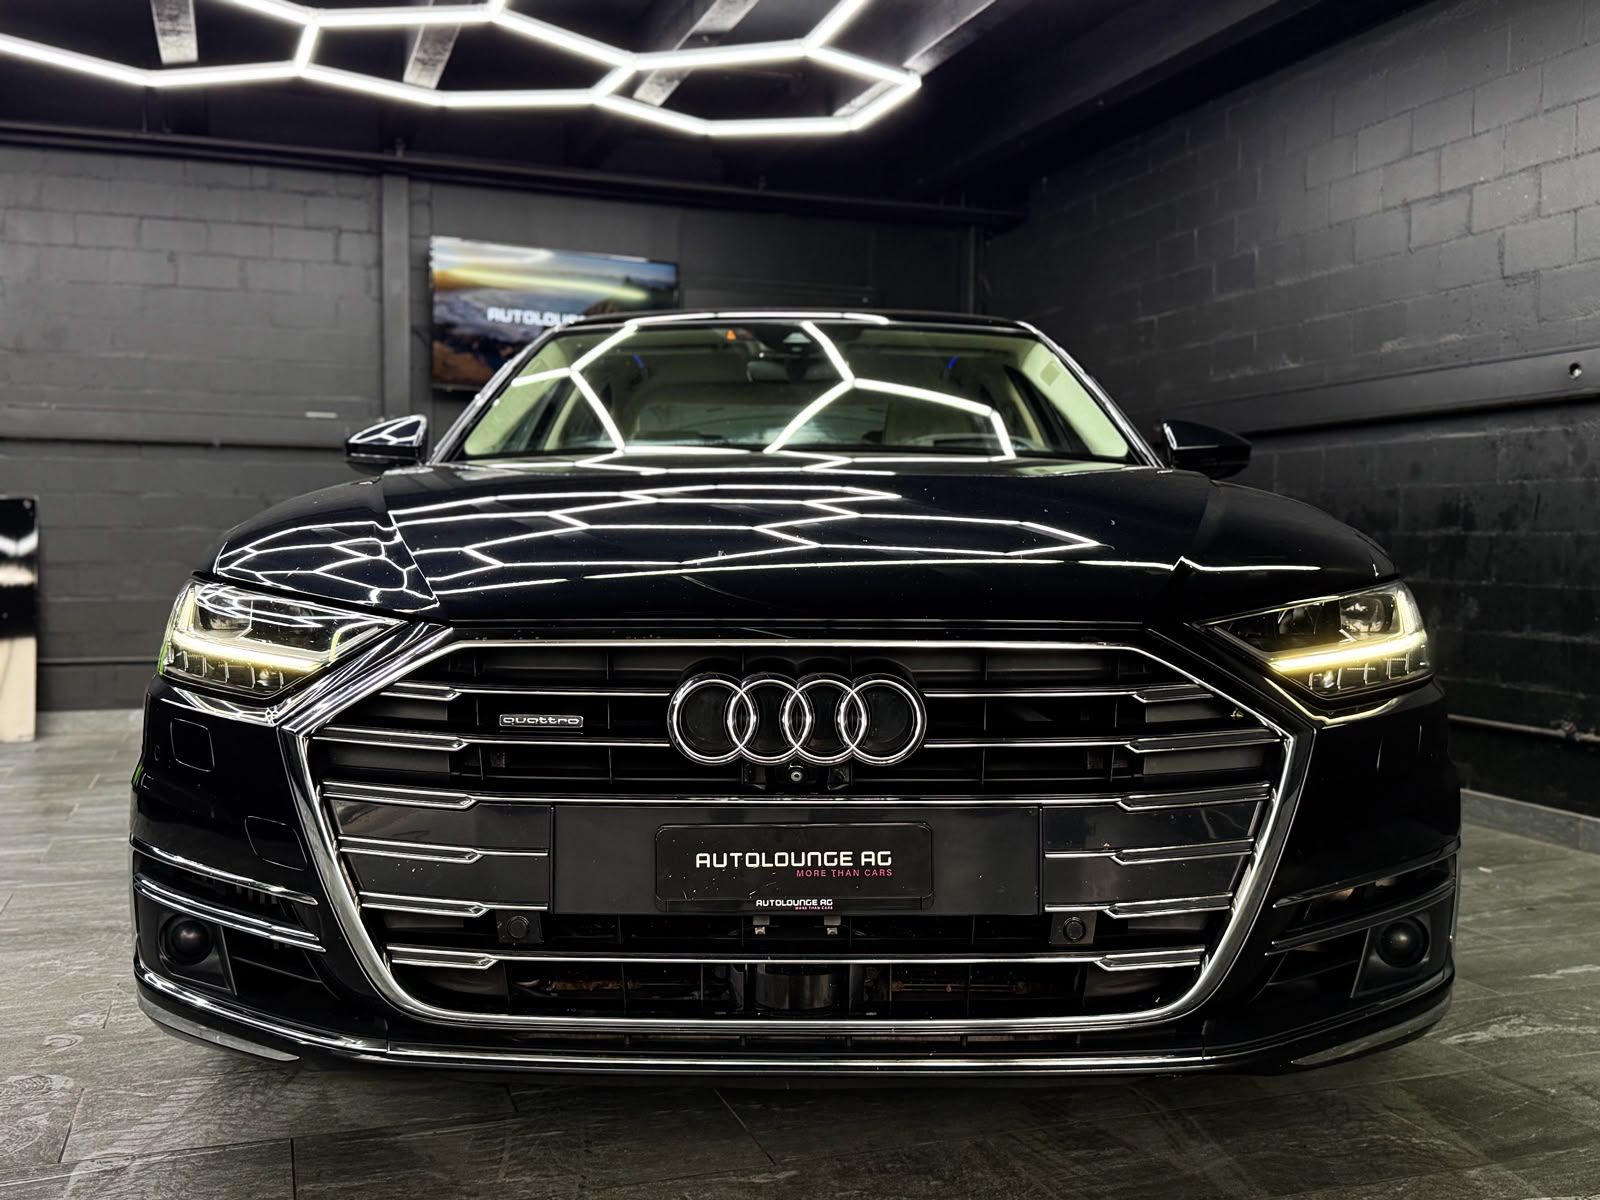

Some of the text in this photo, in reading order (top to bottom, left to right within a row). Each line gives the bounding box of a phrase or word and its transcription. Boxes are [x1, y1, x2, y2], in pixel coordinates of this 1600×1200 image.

[503, 716, 579, 725] quattro
[695, 850, 892, 868] AUTOLOUNGE AG
[796, 868, 893, 878] MORE THAN CARS
[755, 898, 833, 907] AUTOLOUNGE AG
